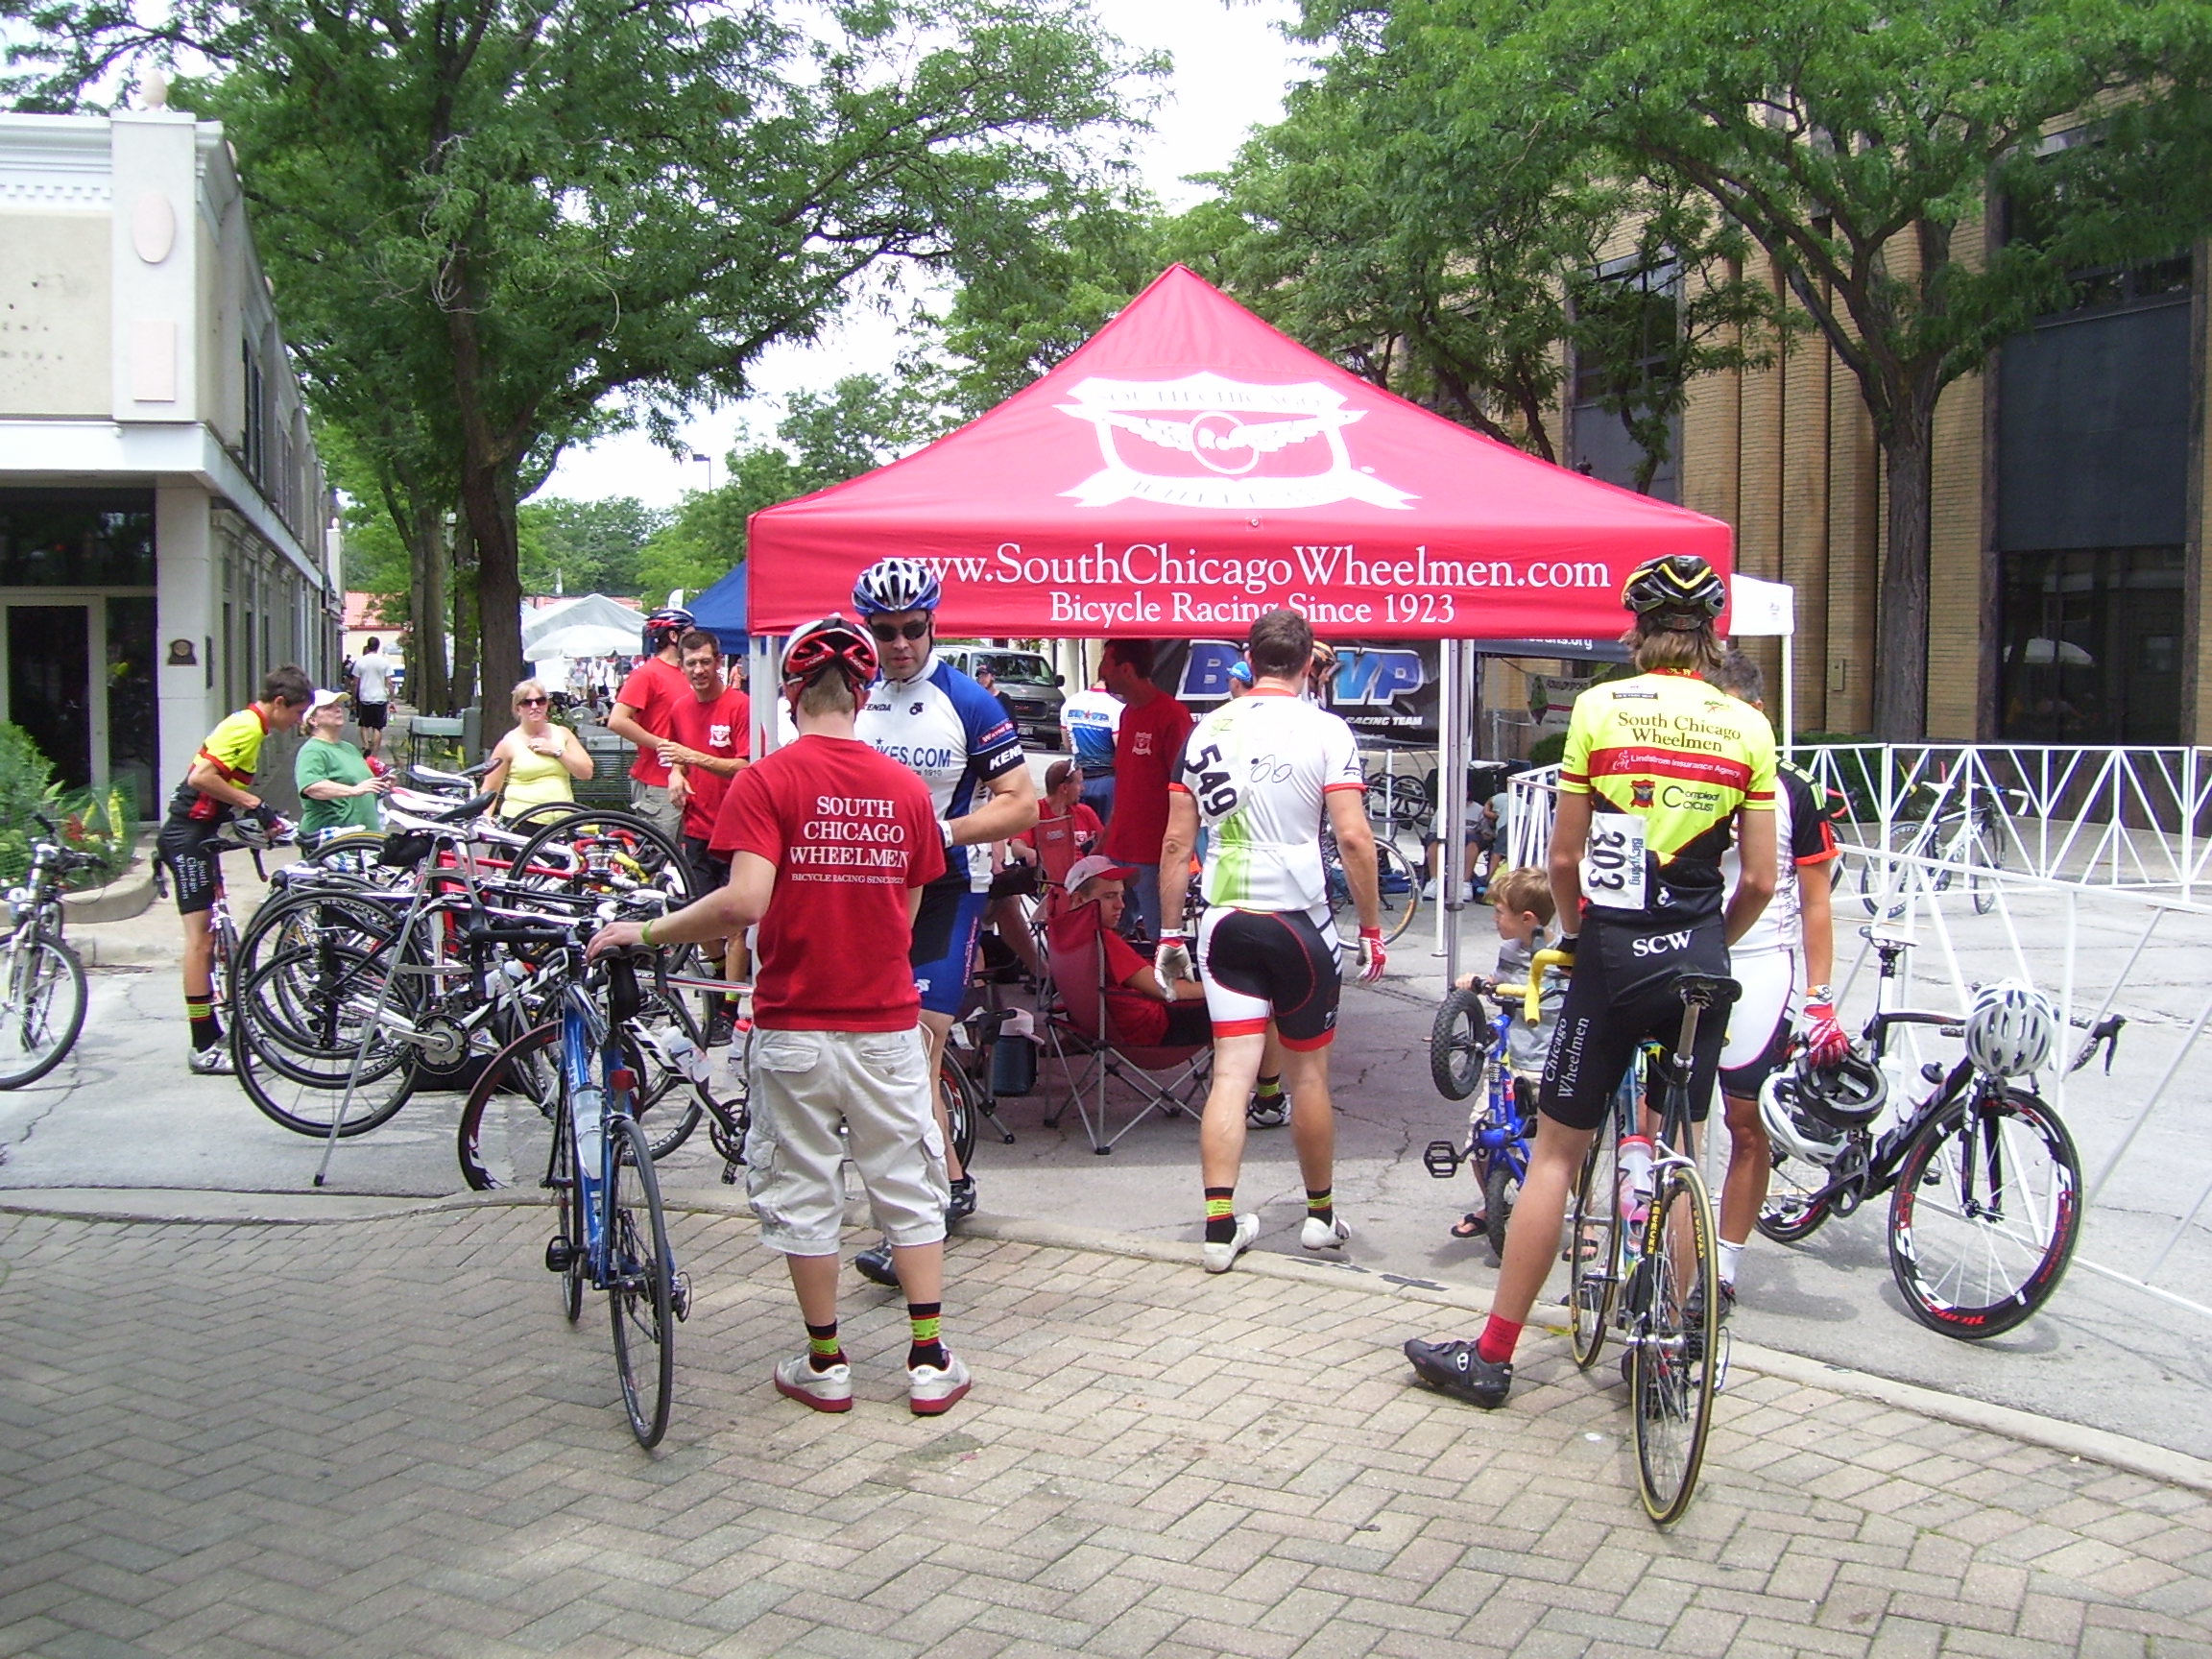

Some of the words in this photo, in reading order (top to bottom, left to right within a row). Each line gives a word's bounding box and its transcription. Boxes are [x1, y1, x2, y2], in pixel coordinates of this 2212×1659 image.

[1050, 591, 1162, 628] Bicycle
[1171, 592, 1279, 622] Racing
[1287, 593, 1372, 624] Since
[1384, 594, 1455, 624] 1923
[865, 703, 891, 711] ENDA
[1392, 716, 1423, 726] TEAM
[1618, 712, 1668, 729] South
[1674, 715, 1741, 741] Chicago
[1631, 728, 1722, 753] Wheelmen
[1631, 755, 1671, 766] Lindstrom
[1671, 759, 1714, 771] Insurance
[1184, 743, 1238, 817] 549
[817, 796, 895, 819] SOUTH
[804, 821, 905, 844] CHICAGO
[789, 846, 910, 868] WHEELMEN
[1587, 830, 1626, 891] 303
[791, 873, 831, 882] BICYCLE
[1632, 929, 1693, 957] SCW
[1544, 1018, 1568, 1082] Chicago
[1557, 1018, 1590, 1097] Wheelmen
